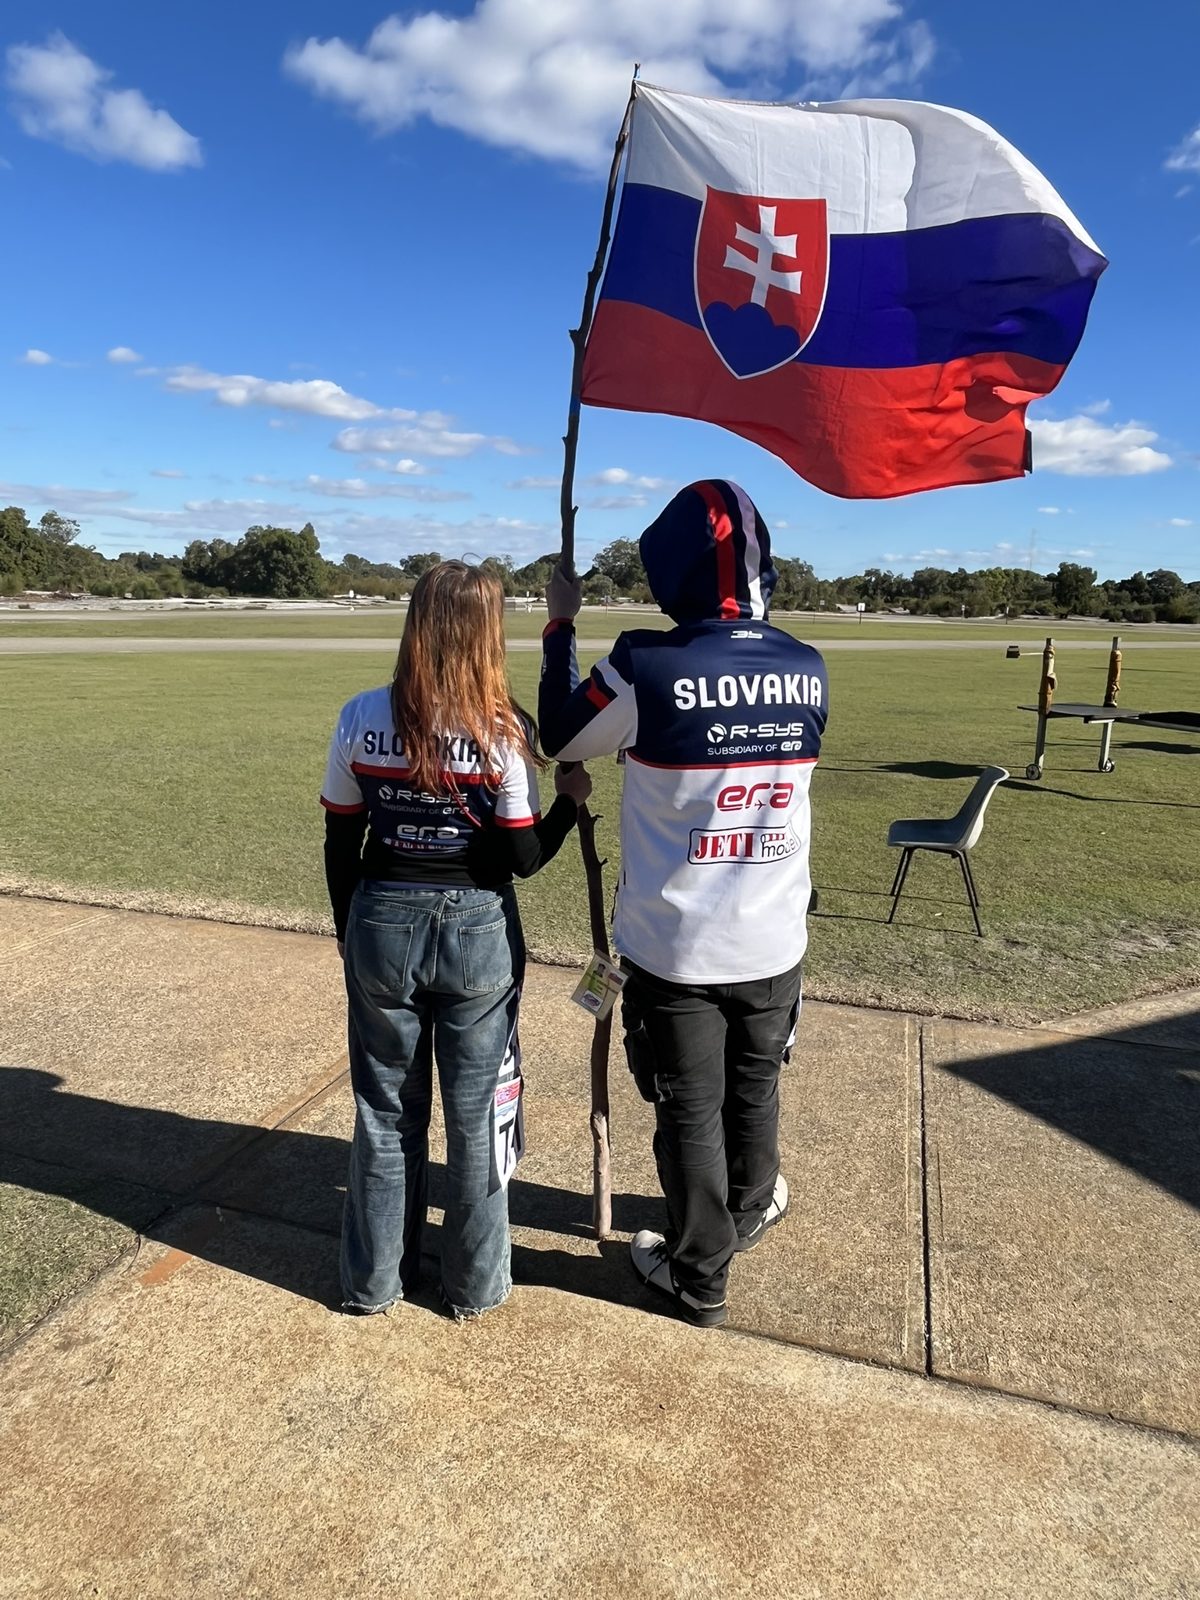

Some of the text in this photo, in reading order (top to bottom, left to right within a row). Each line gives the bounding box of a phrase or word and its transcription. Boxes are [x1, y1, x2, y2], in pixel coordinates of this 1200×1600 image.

[673, 673, 822, 711] SLOVAKIA
[363, 730, 482, 763] SLOKIA
[707, 745, 764, 756] SUBSIDIARY
[765, 743, 778, 752] OF
[428, 807, 441, 815] OF
[717, 782, 794, 812] era
[396, 824, 459, 842] era
[694, 832, 755, 860] JETI
